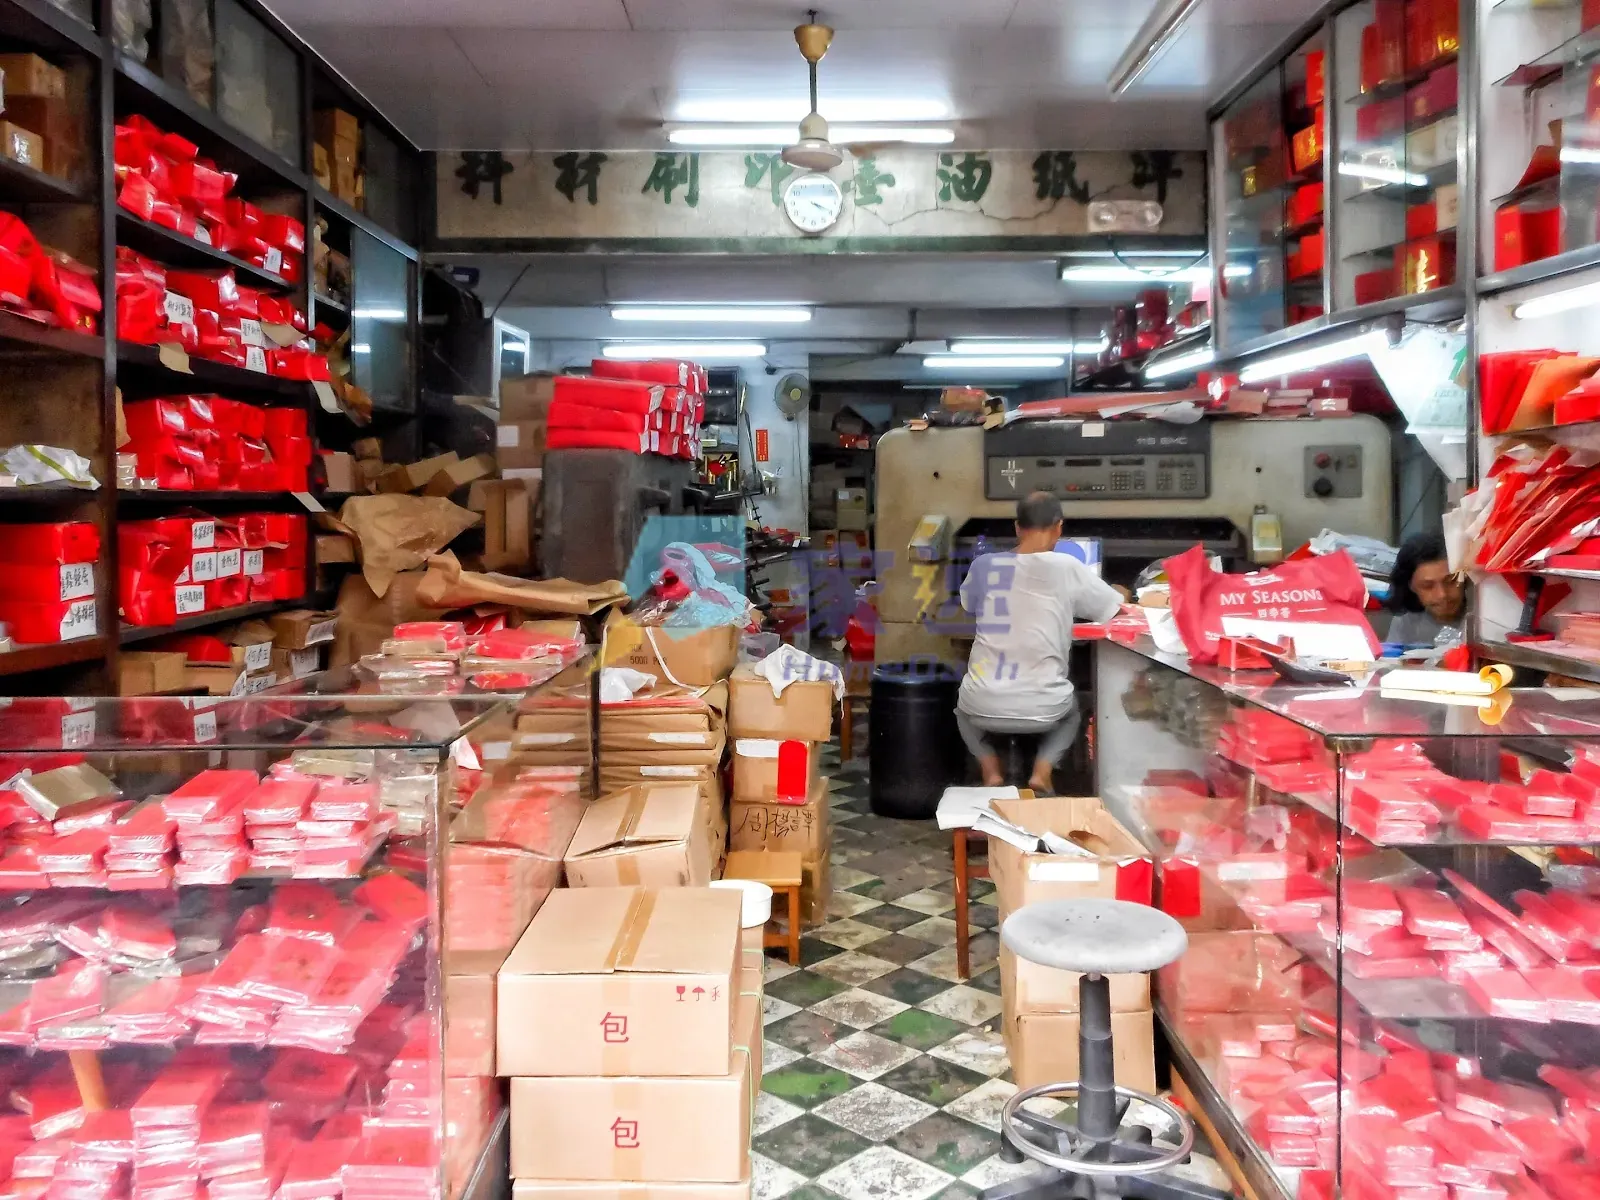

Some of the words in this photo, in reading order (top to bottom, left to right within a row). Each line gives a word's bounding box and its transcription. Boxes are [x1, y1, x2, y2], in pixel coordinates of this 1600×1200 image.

[1220, 592, 1246, 606] MY
[1252, 588, 1324, 605] SEASONS
[599, 1011, 630, 1044] 包
[610, 1116, 641, 1149] 包
